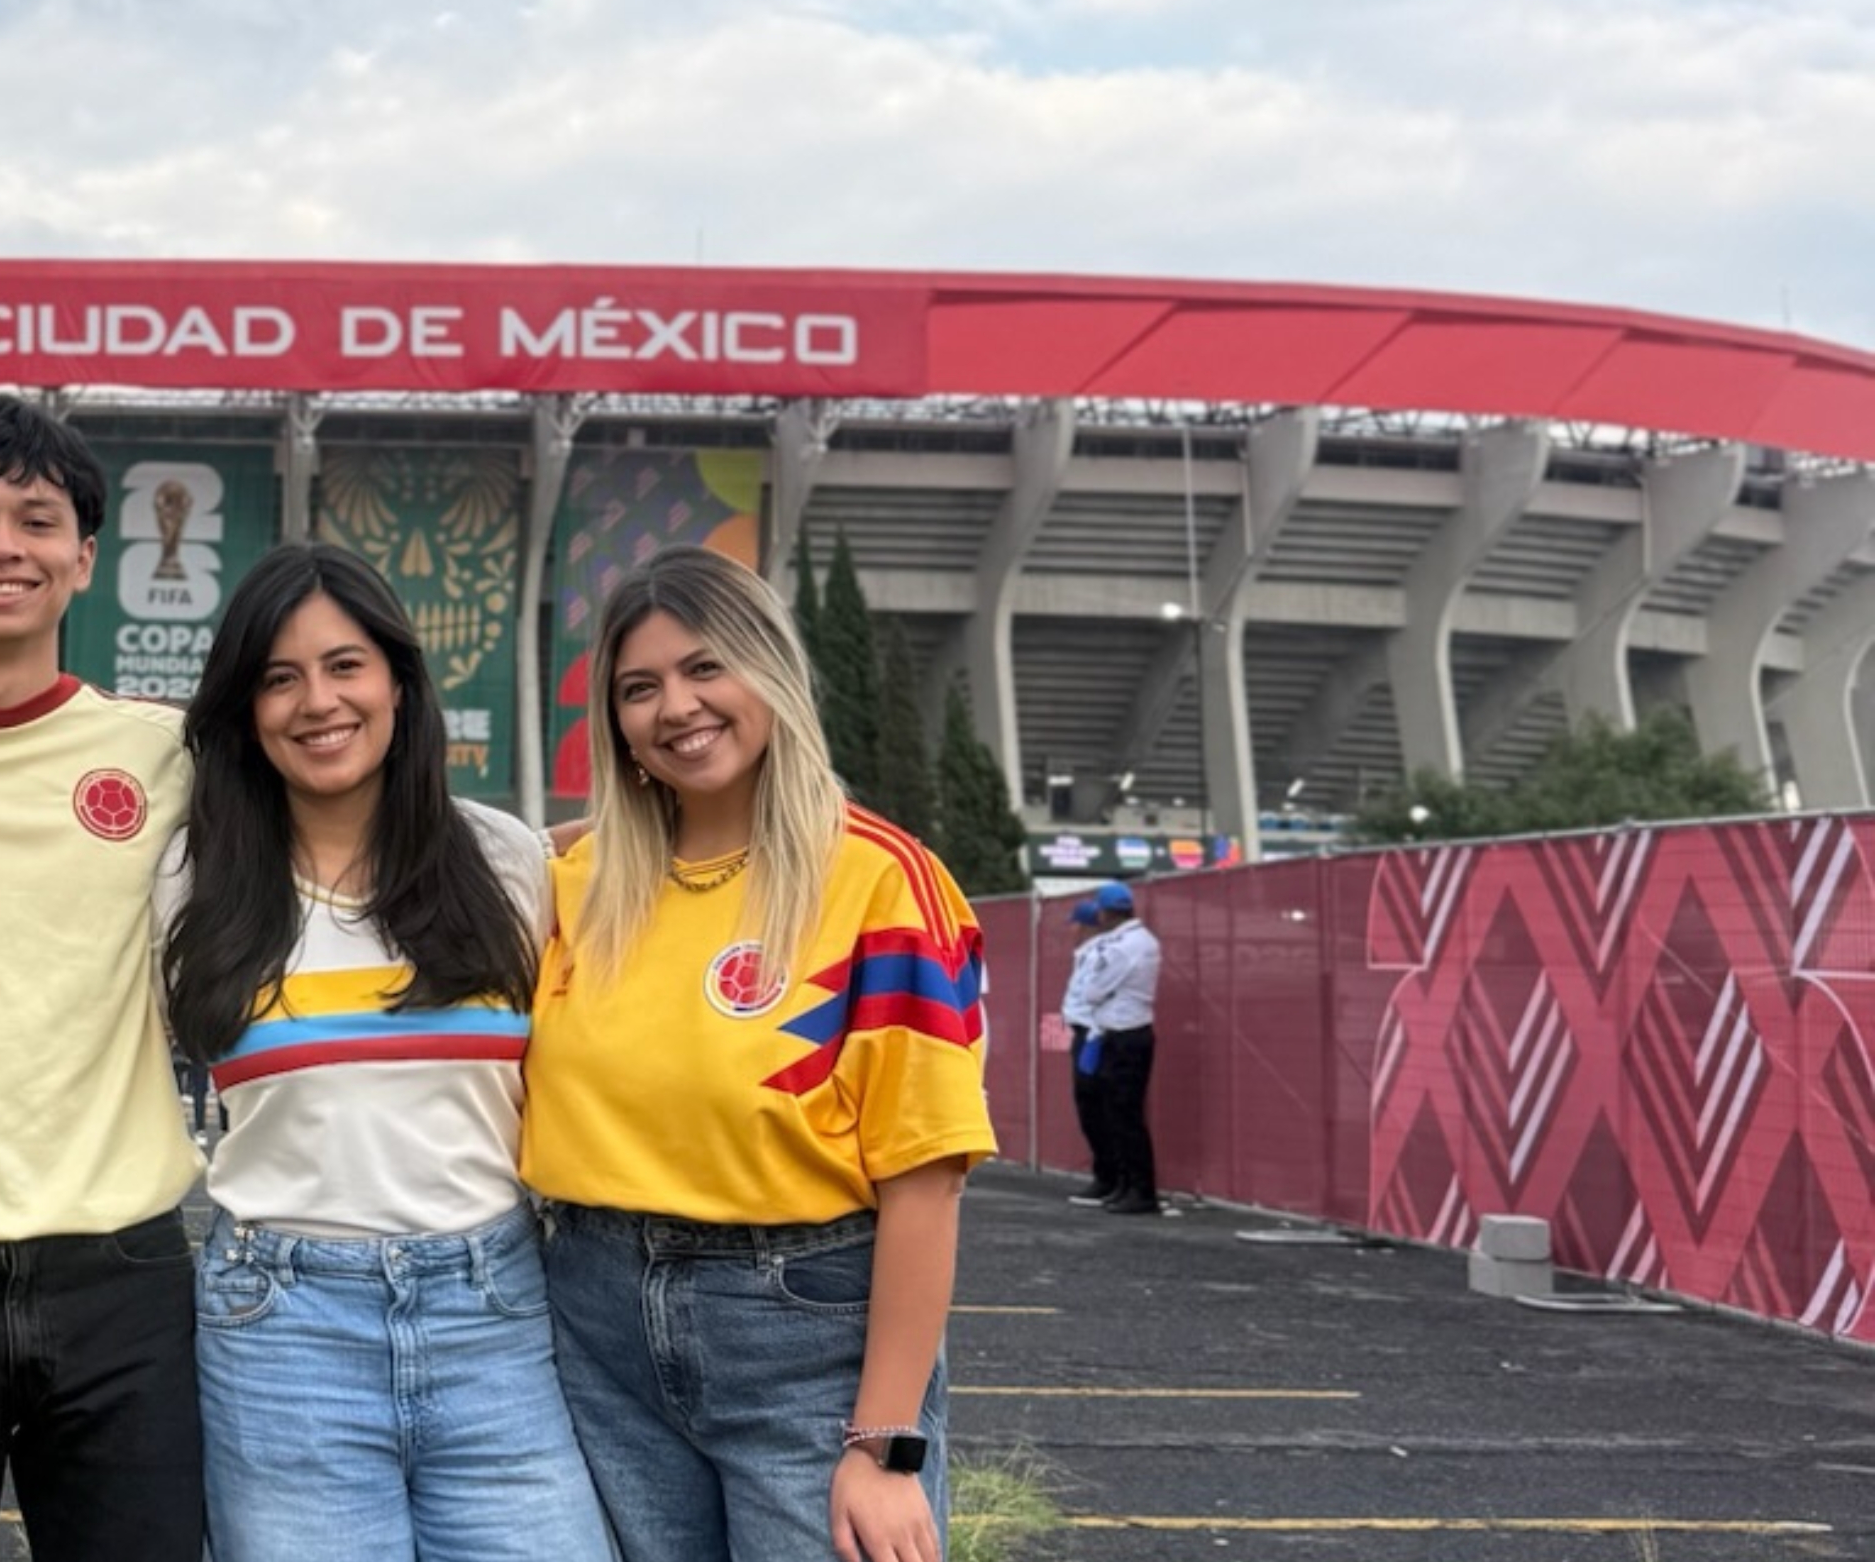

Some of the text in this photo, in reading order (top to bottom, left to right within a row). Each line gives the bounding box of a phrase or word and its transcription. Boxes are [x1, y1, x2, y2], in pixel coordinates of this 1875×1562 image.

[340, 306, 463, 357] DE
[500, 296, 857, 365] MÉXICO
[148, 588, 193, 606] FIFA
[116, 624, 214, 654] COPA
[115, 655, 204, 674] MUNDIA
